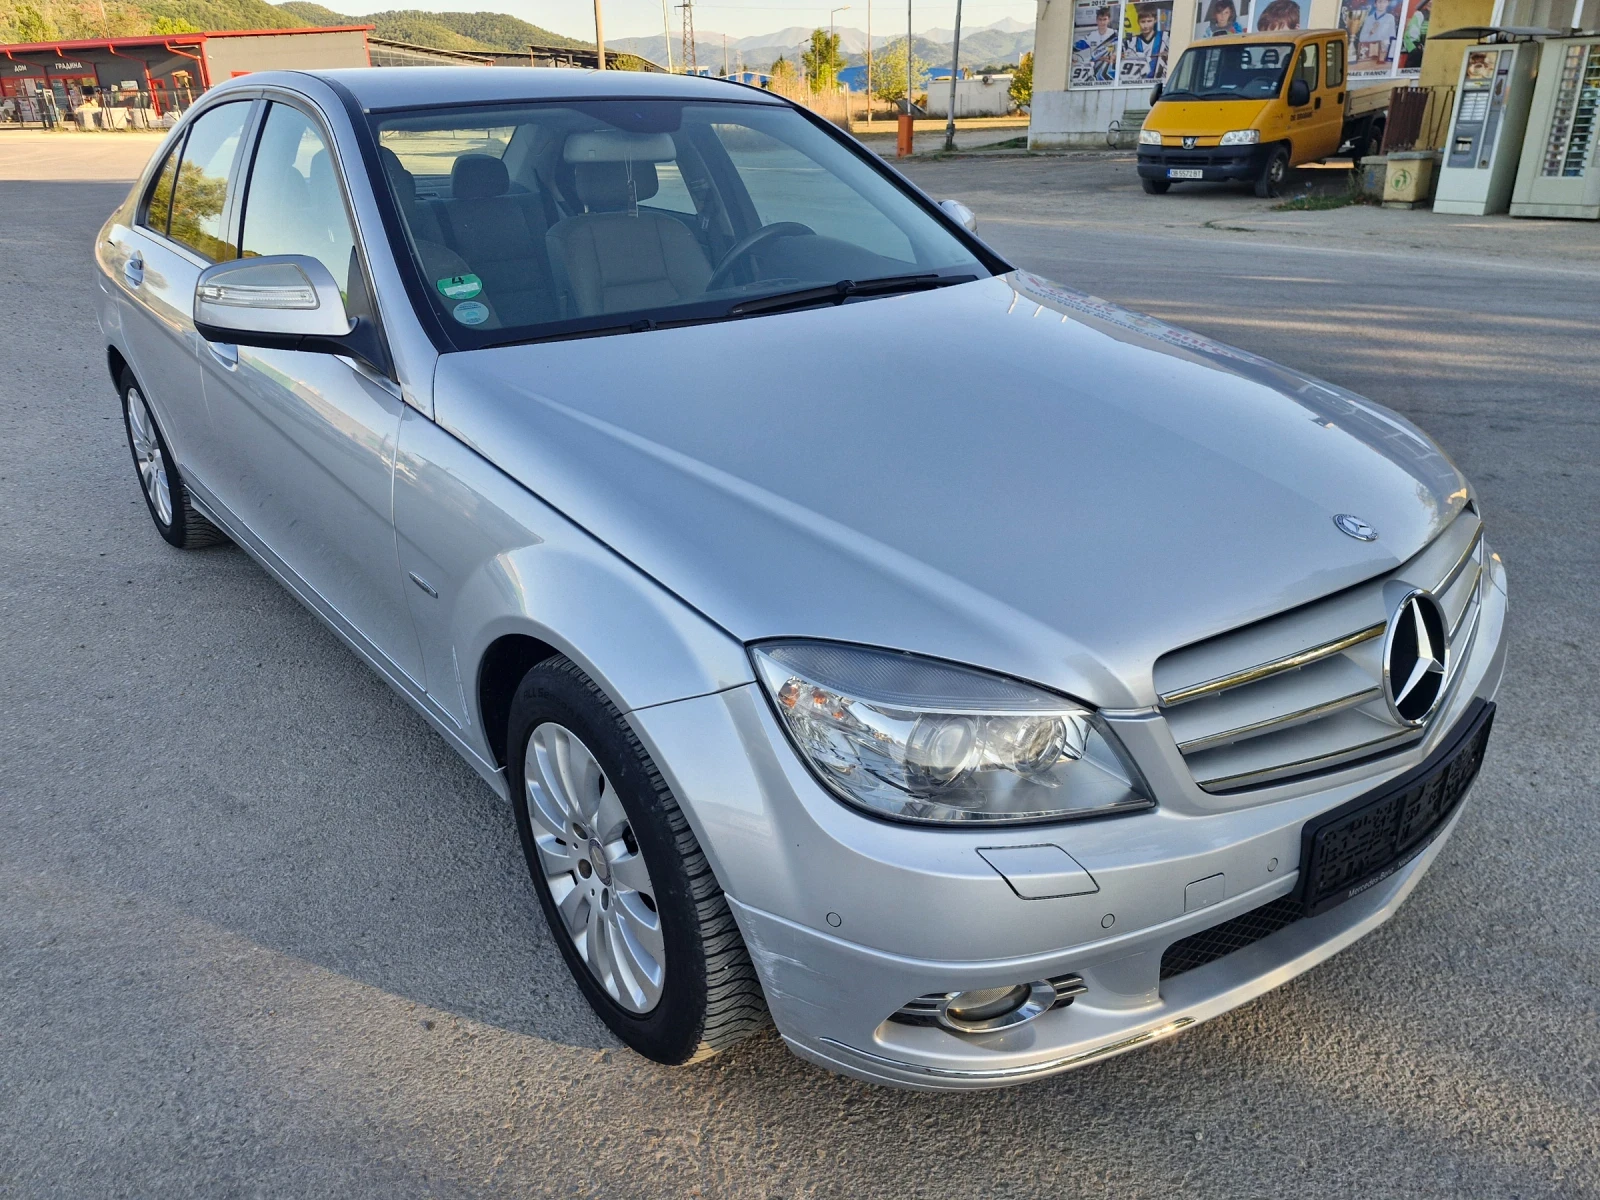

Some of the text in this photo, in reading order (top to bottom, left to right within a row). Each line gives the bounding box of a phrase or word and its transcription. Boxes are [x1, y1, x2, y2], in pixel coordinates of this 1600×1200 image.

[55, 62, 83, 70] ГРАДИНА
[1121, 62, 1145, 76] 97
[1073, 68, 1090, 79] 97
[1347, 867, 1395, 899] Mercedes-Benz
